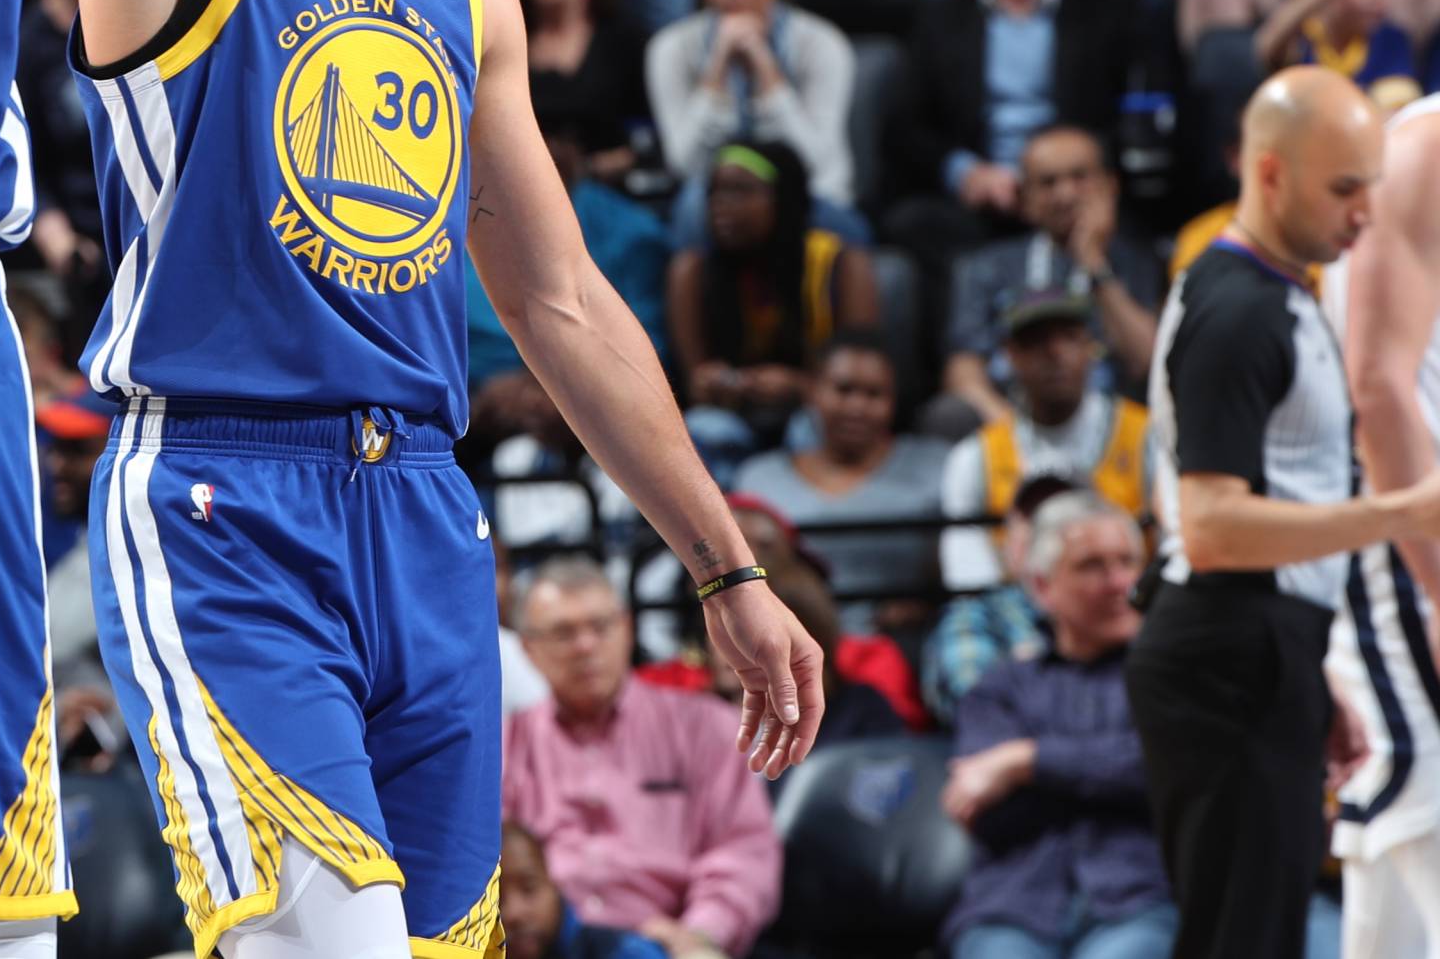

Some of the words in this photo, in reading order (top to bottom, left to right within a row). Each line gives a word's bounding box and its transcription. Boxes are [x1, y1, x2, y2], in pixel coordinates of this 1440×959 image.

[372, 70, 439, 140] 30
[268, 193, 453, 295] WARRIORS
[361, 427, 385, 452] W
